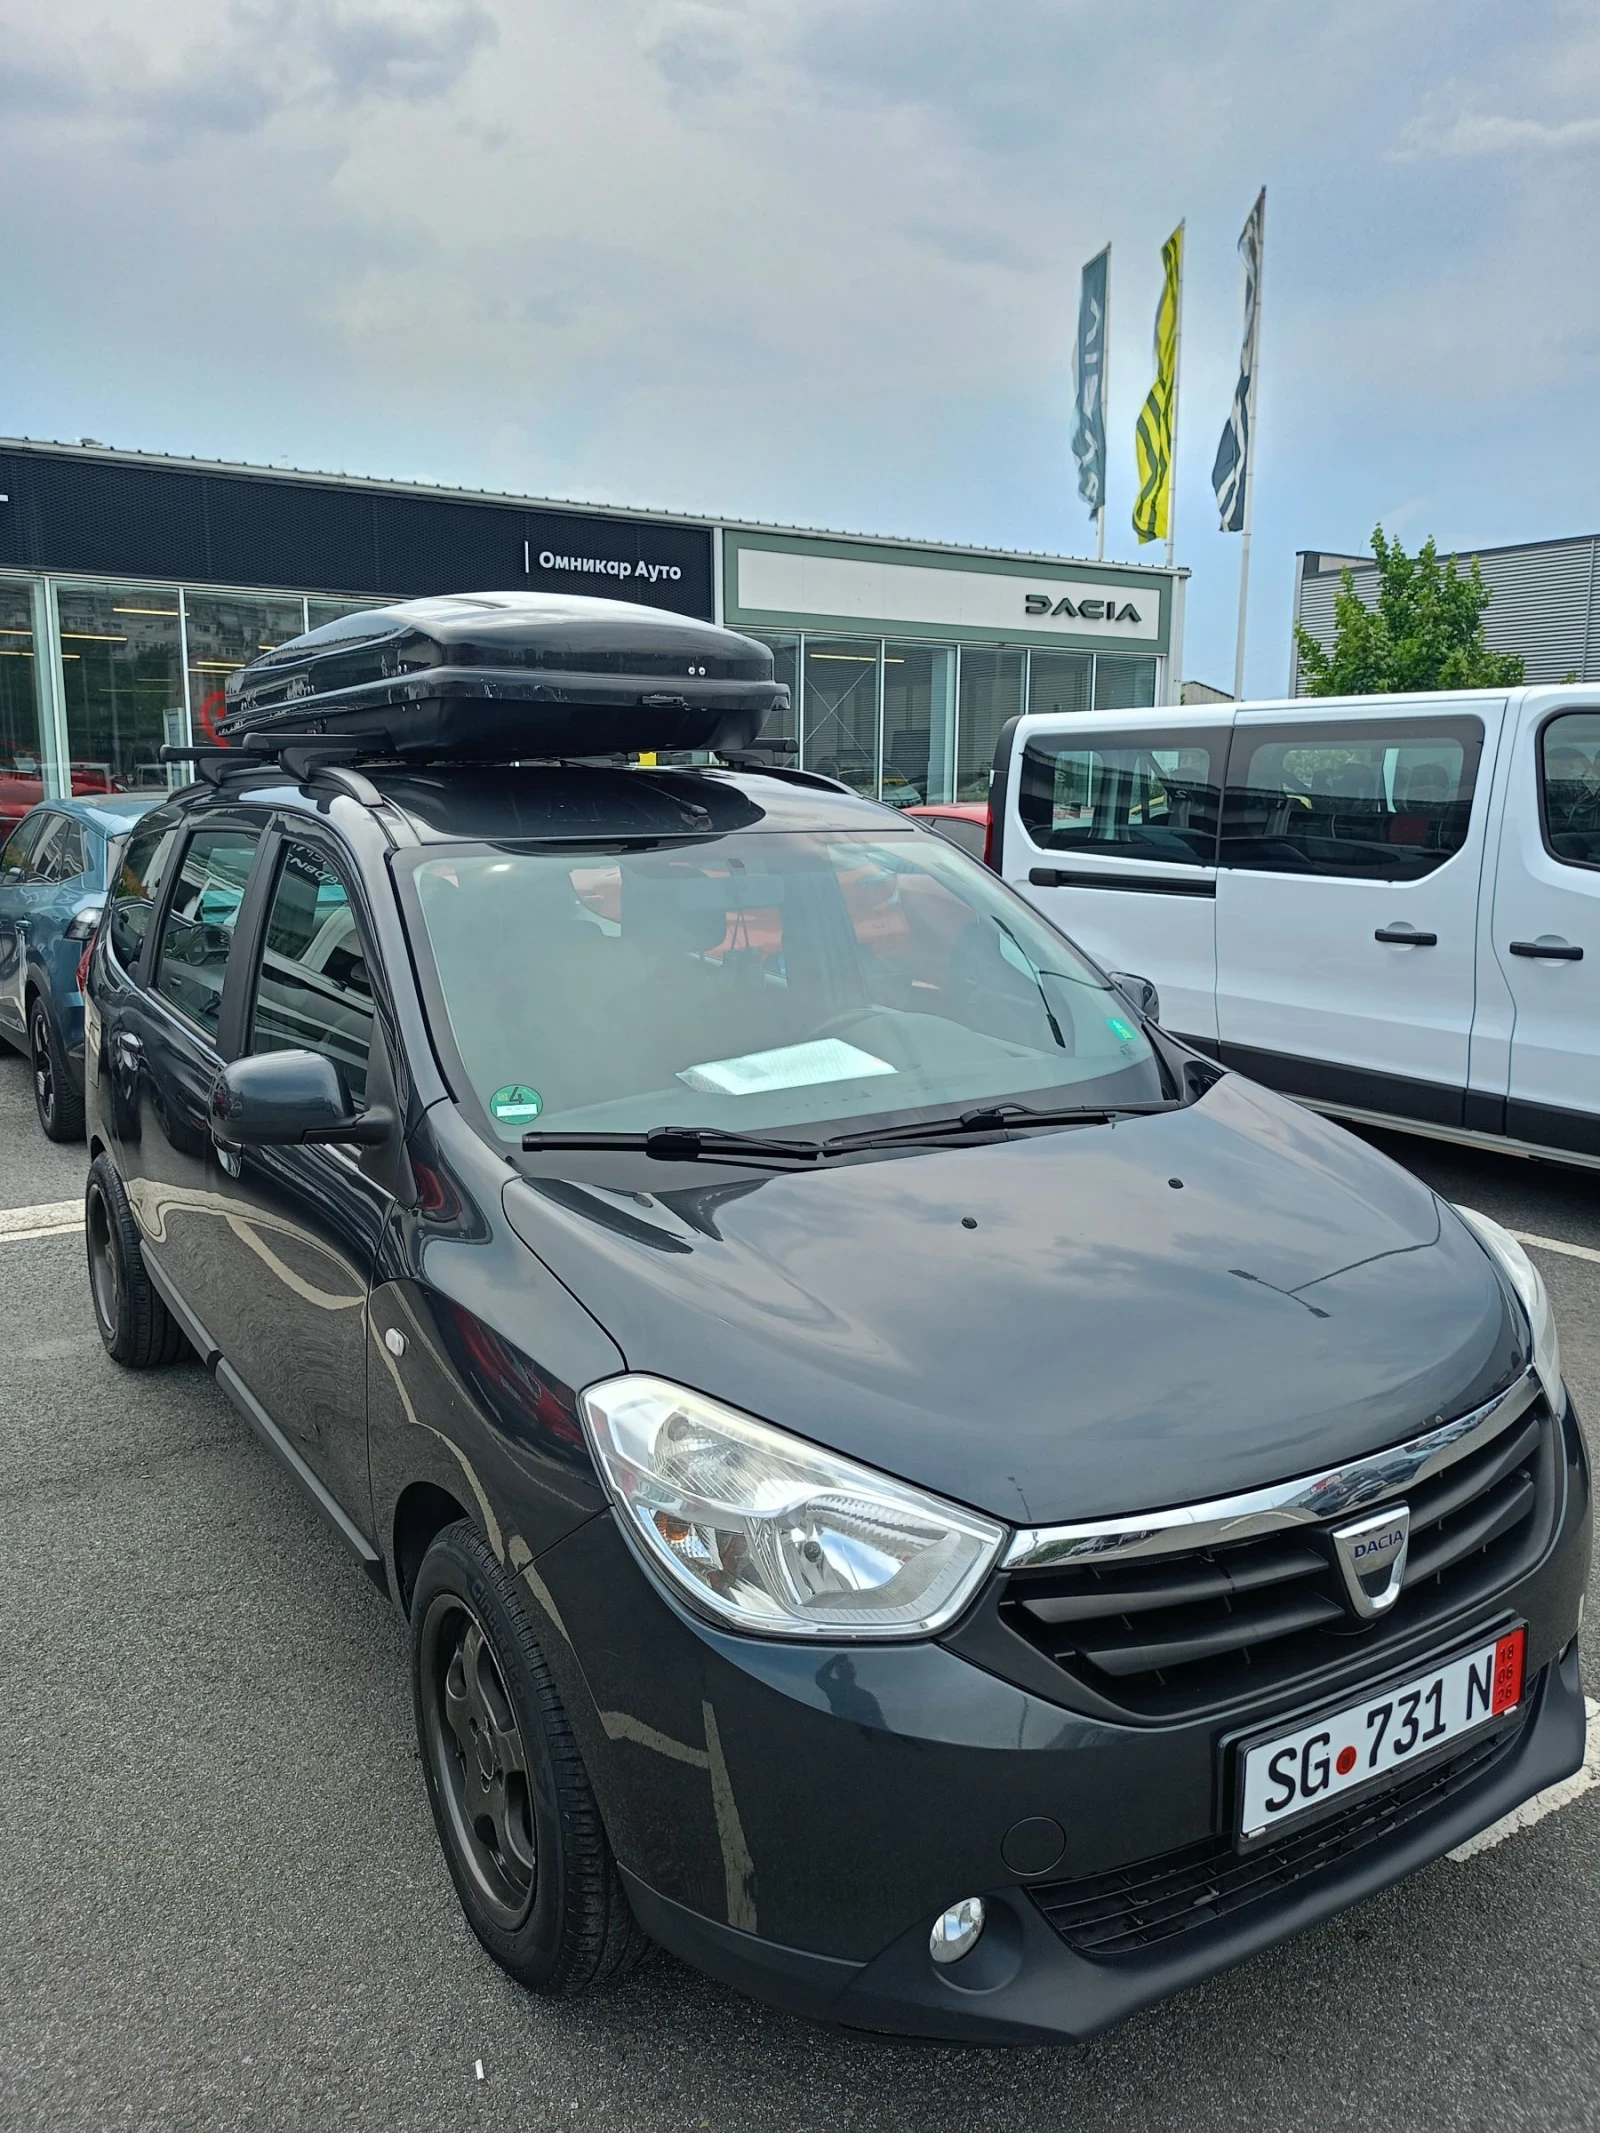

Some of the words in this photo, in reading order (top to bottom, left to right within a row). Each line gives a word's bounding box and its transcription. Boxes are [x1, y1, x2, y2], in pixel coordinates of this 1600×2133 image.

[539, 551, 631, 580] Омникар
[634, 560, 682, 582] Ауто
[1025, 594, 1142, 622] DACIA
[509, 1087, 524, 1104] 4
[1354, 1530, 1403, 1559] DACIA
[1265, 1732, 1330, 1812] SG
[1367, 1678, 1446, 1768] 731
[1466, 1654, 1493, 1721] N
